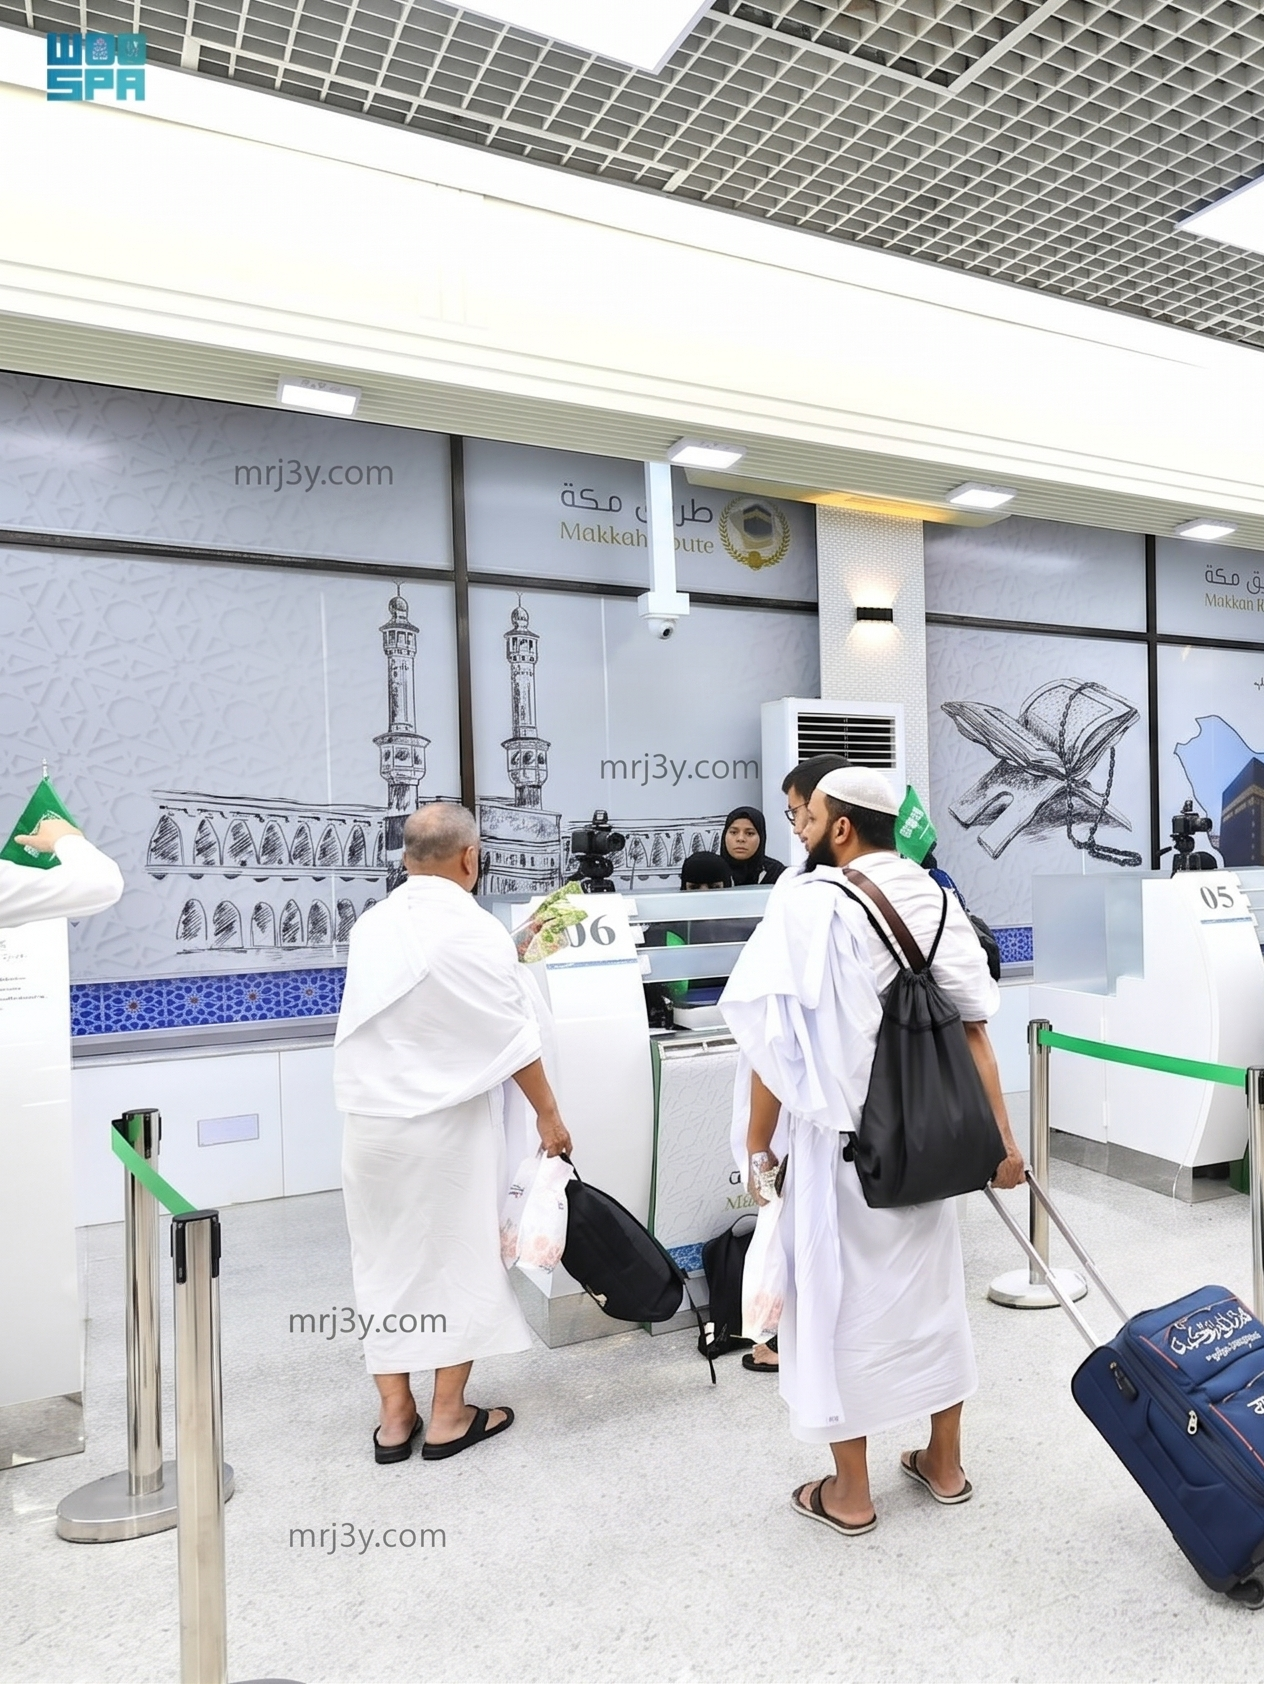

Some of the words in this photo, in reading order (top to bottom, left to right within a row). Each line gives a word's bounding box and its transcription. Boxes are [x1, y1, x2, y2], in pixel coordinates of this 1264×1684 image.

[561, 482, 622, 513] مكة
[560, 521, 648, 548] Makkah
[1205, 564, 1240, 586] مكة
[1200, 886, 1234, 909] 05
